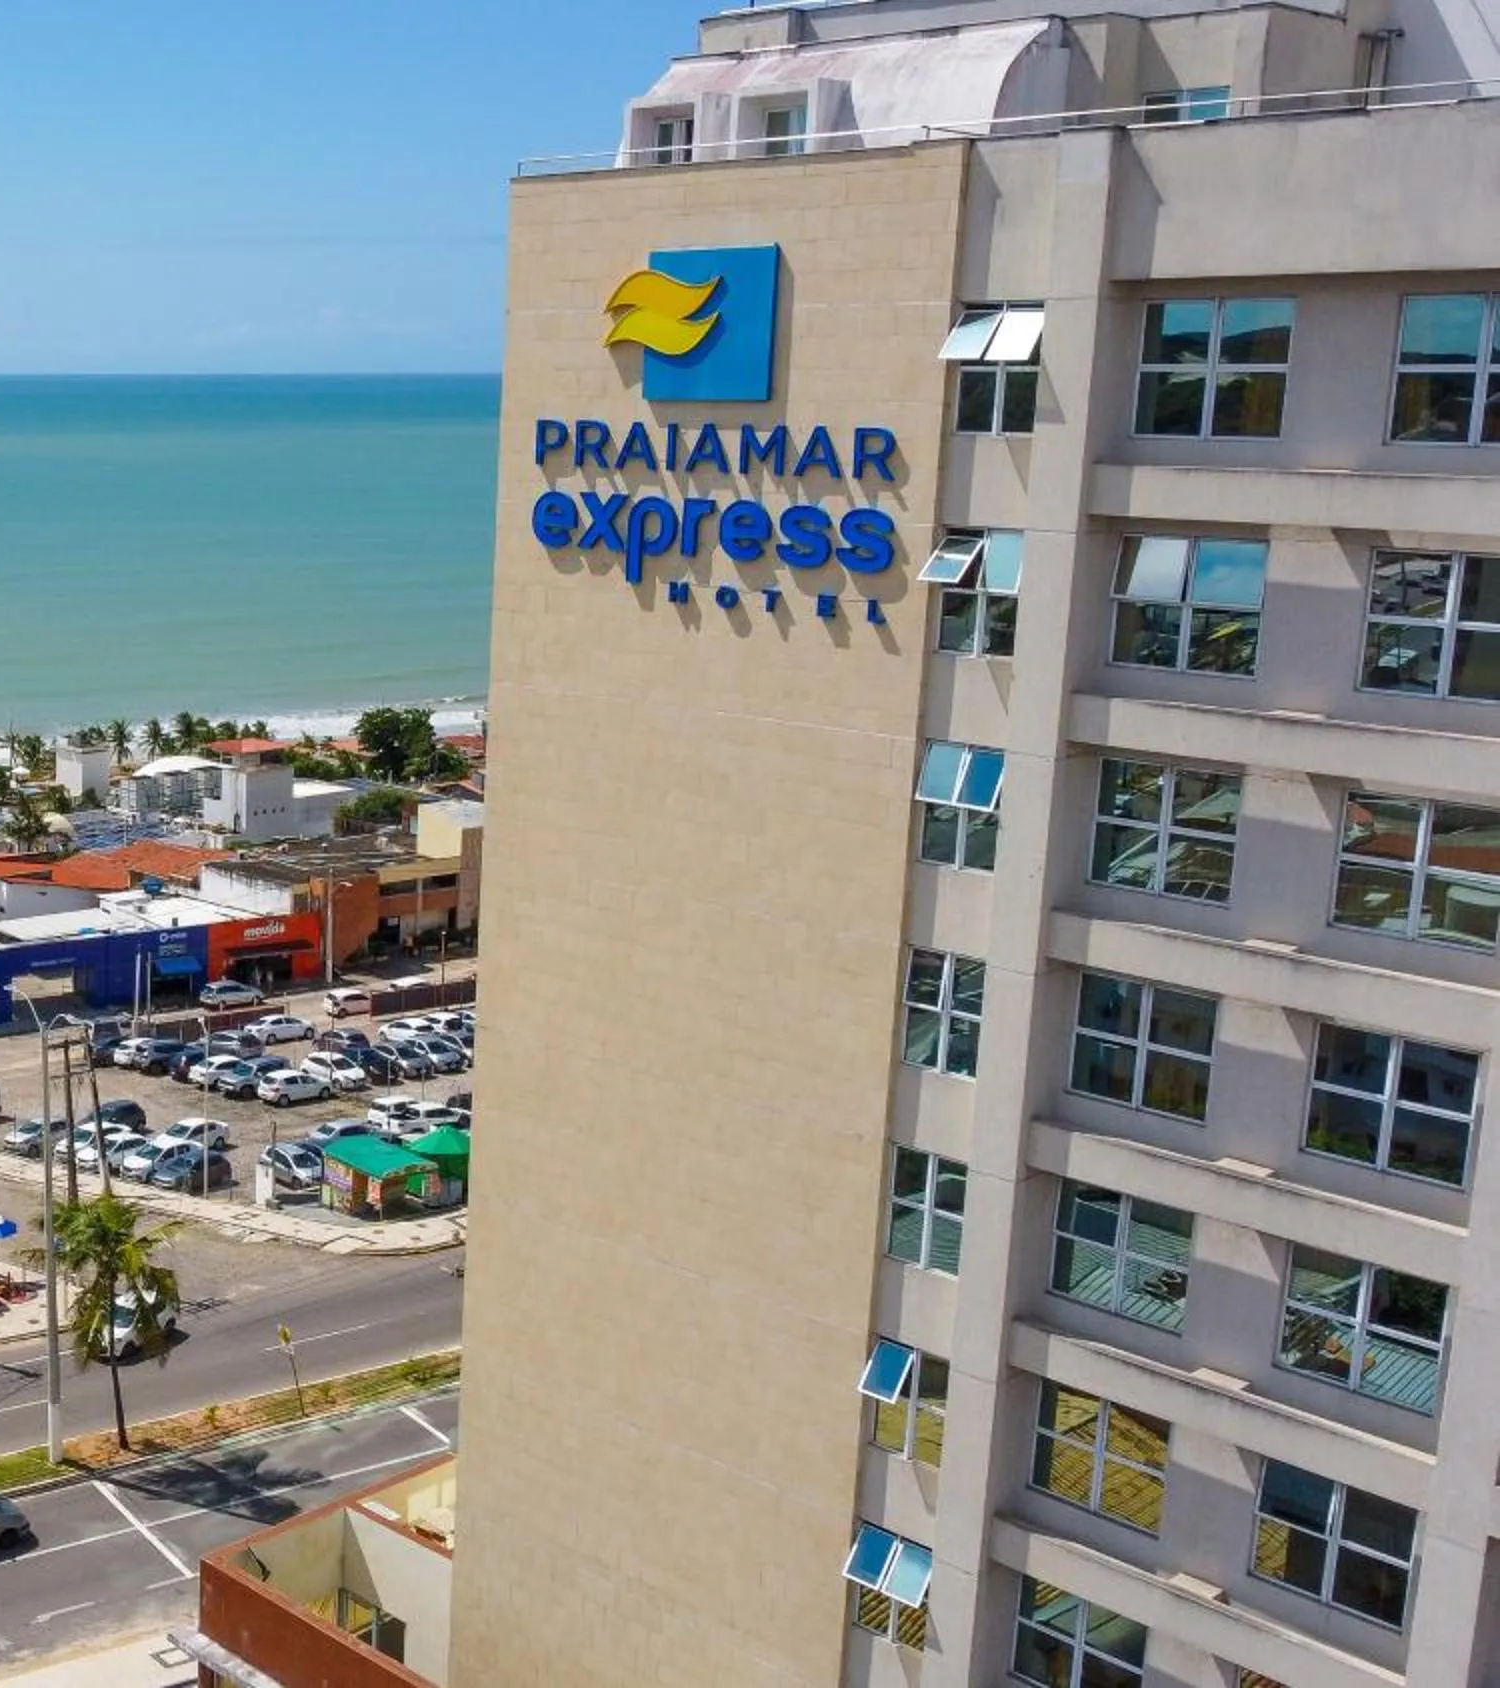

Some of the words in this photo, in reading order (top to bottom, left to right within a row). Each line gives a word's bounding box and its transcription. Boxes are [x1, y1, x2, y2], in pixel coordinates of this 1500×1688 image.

[535, 419, 897, 481] PRAIAMAR
[531, 490, 896, 584] express
[667, 580, 887, 624] HOTEL
